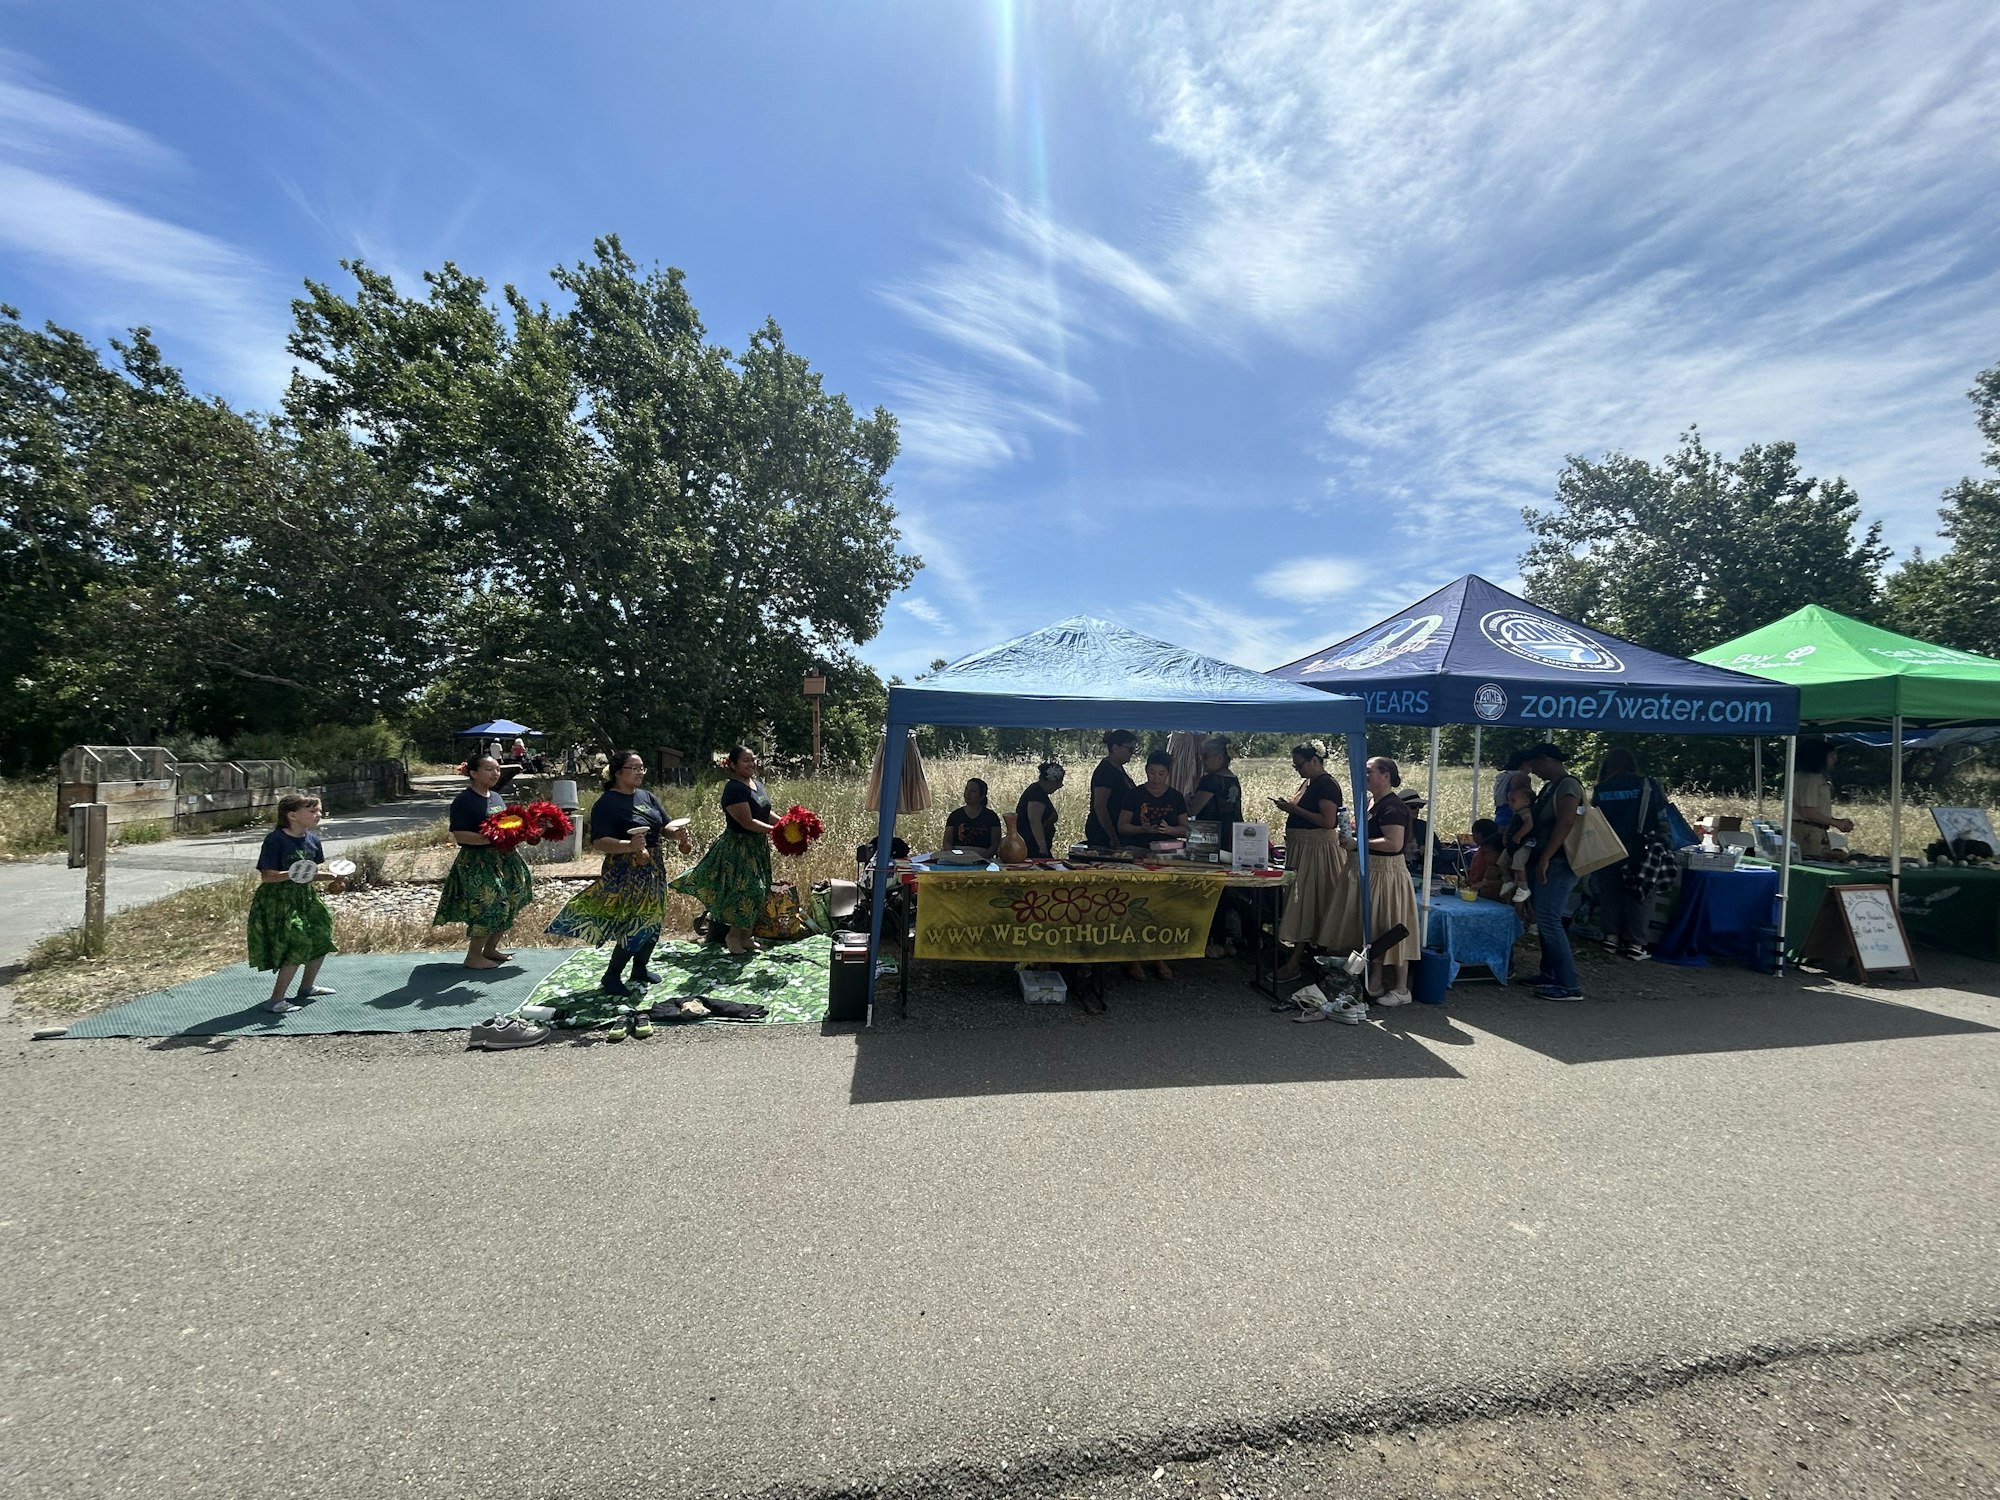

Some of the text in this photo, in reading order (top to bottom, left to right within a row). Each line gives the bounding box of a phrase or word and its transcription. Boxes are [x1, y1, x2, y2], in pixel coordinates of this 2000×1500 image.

[1505, 621, 1580, 644] ZONE
[1530, 643, 1585, 664] 7
[1363, 690, 1429, 714] YEARS
[1481, 690, 1501, 702] ZONE
[1520, 690, 1772, 723] zone7water.com
[1482, 704, 1498, 715] 7
[926, 922, 1191, 946] WWW.WEGOTHULA.COM
